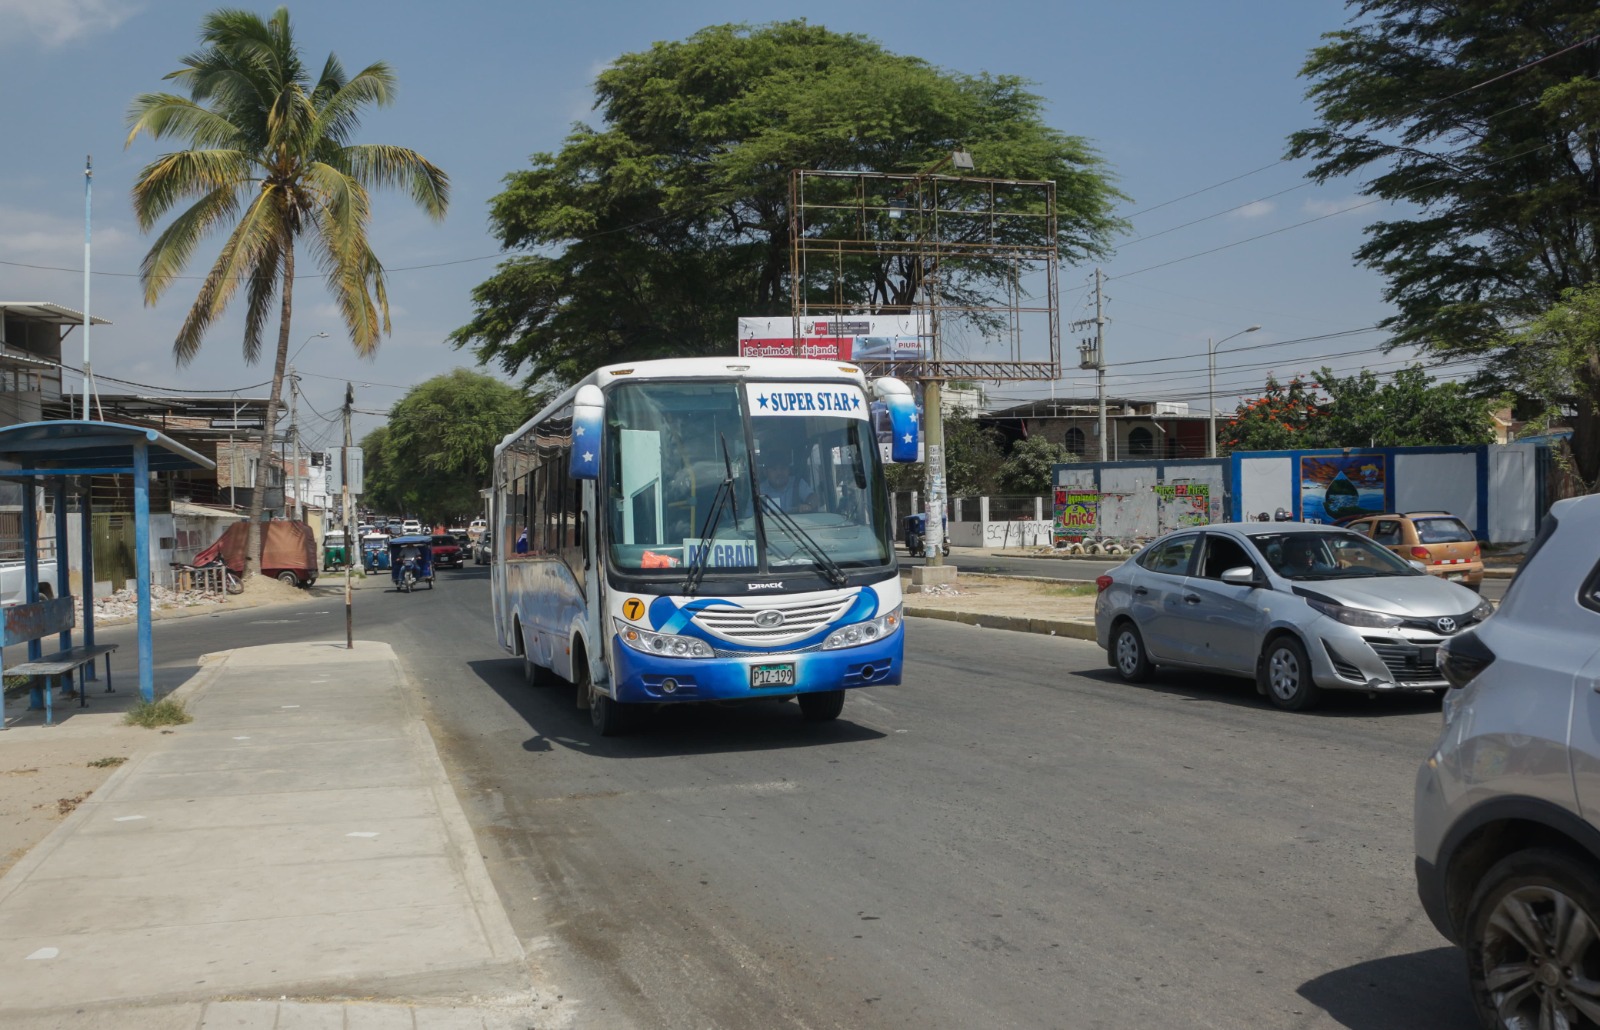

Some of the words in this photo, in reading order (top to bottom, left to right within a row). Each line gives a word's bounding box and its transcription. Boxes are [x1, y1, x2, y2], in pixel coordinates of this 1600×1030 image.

[771, 392, 815, 411] SUPER
[817, 392, 851, 411] STAR
[628, 601, 640, 619] 7
[753, 669, 793, 684] P1Z-199
